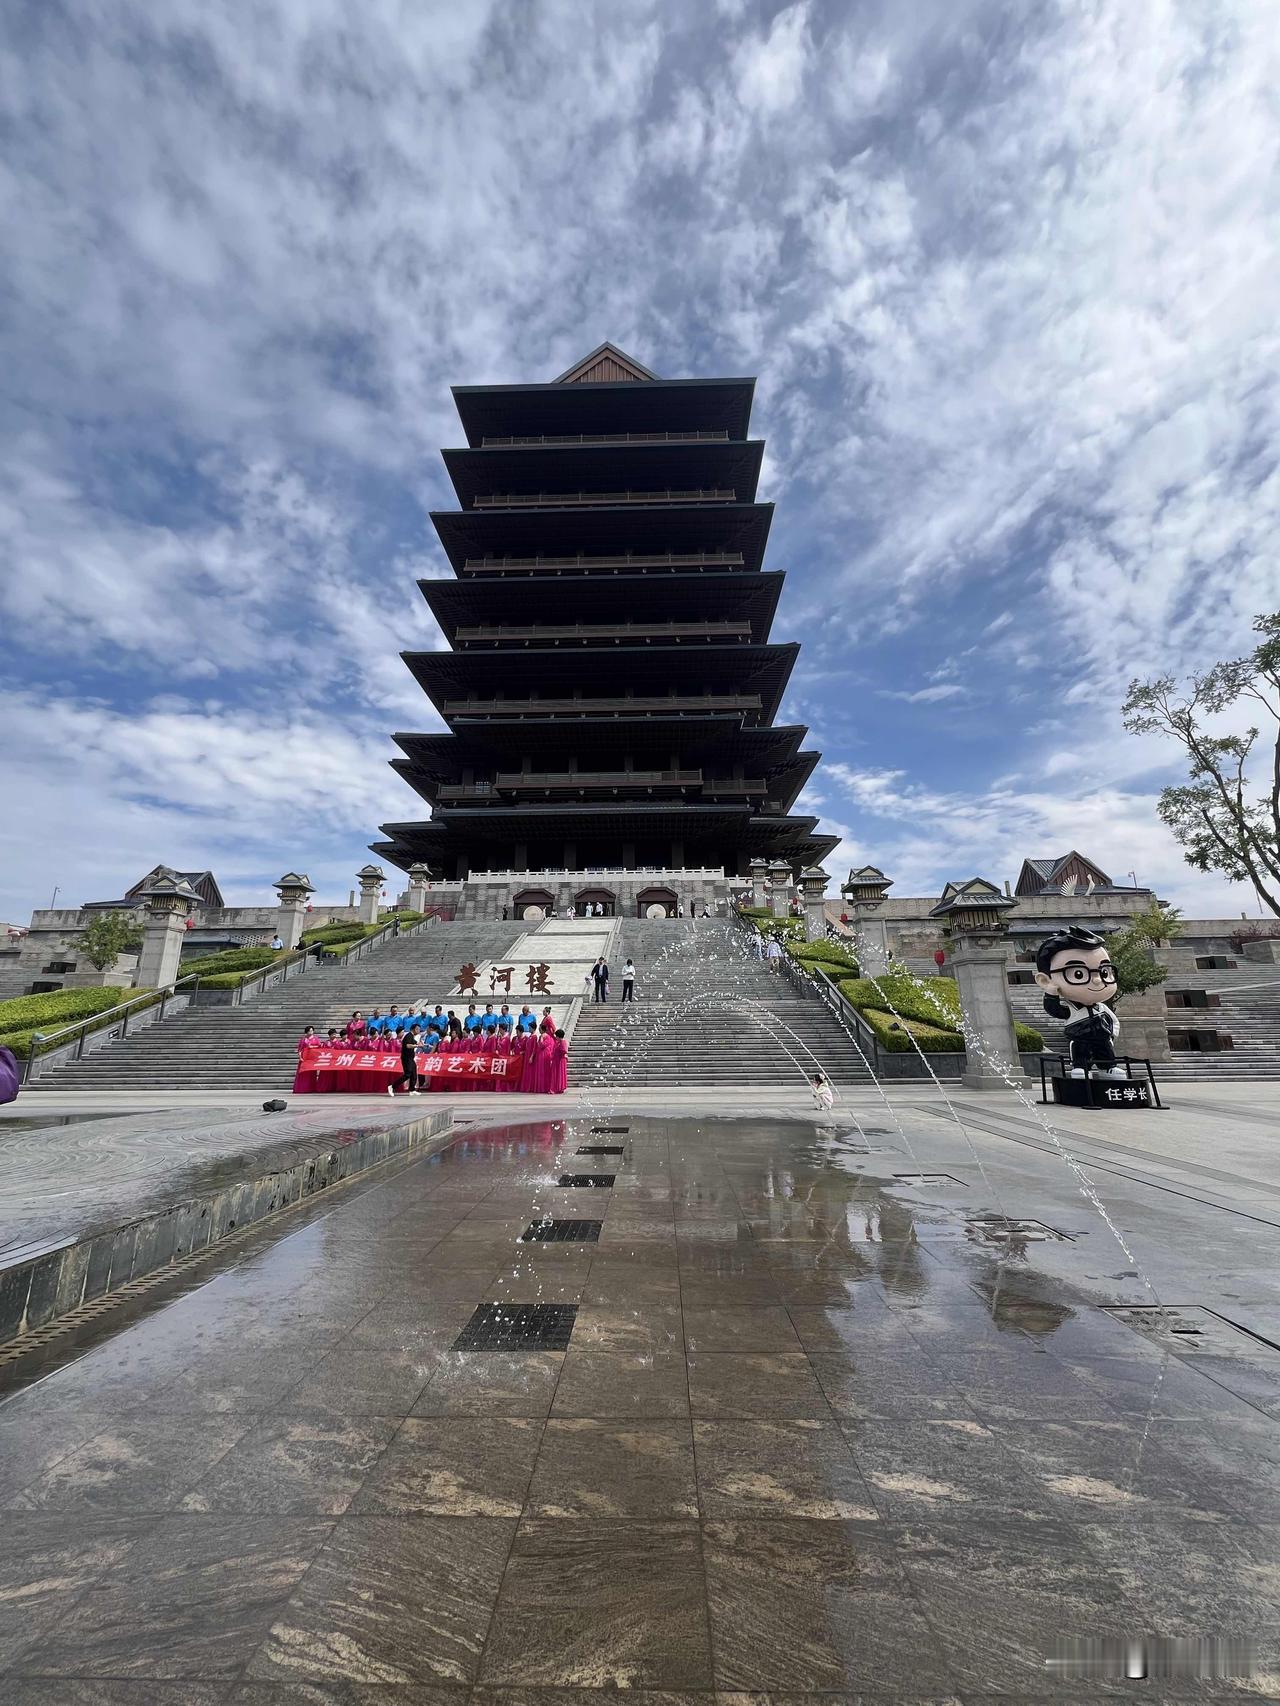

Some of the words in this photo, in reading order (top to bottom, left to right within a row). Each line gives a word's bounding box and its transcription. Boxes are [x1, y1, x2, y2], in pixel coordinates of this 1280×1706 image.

[454, 963, 555, 996] 黄河楼
[314, 1052, 507, 1075] 兰州兰石韵艺术团
[1105, 1087, 1148, 1101] 任学长
